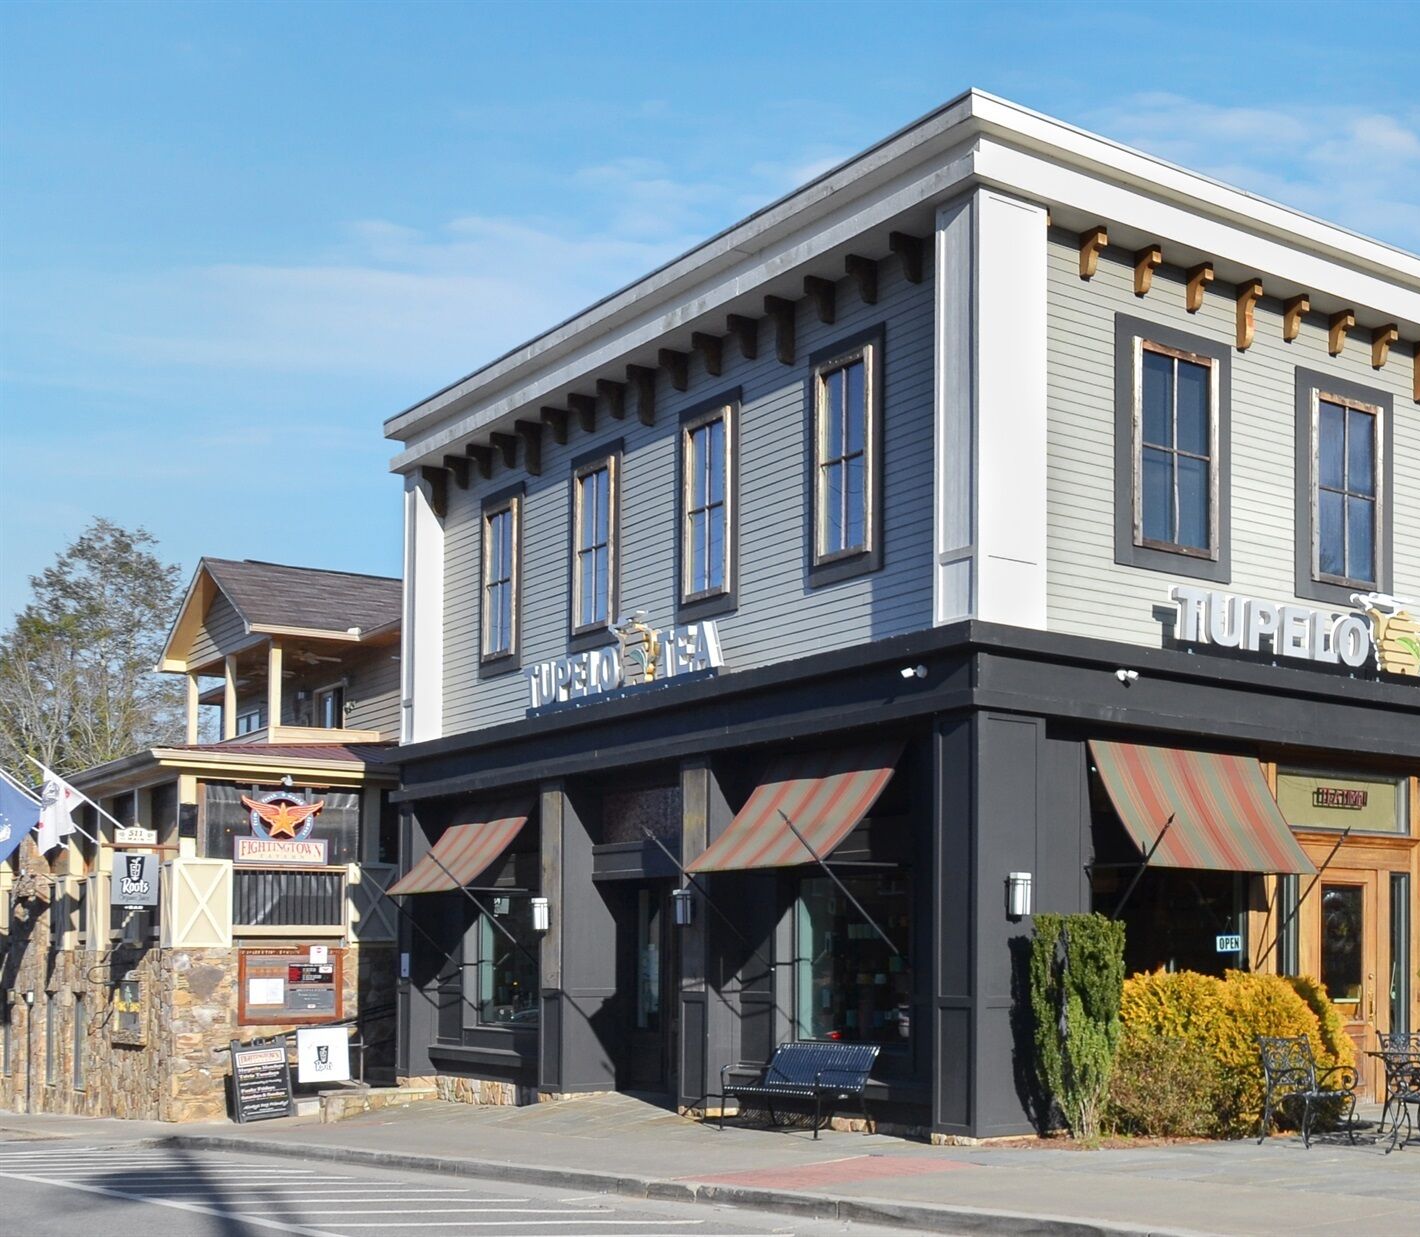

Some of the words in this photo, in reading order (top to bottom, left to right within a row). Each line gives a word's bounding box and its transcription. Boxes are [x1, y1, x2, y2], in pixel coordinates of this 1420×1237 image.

[1169, 584, 1370, 668] TUPELO
[523, 647, 625, 708] TUPELO
[659, 620, 725, 678] TEA
[128, 829, 144, 837] 511
[241, 840, 321, 857] FIGHTINGTOWN
[120, 876, 150, 895] Roots
[1219, 937, 1240, 950] OPEN
